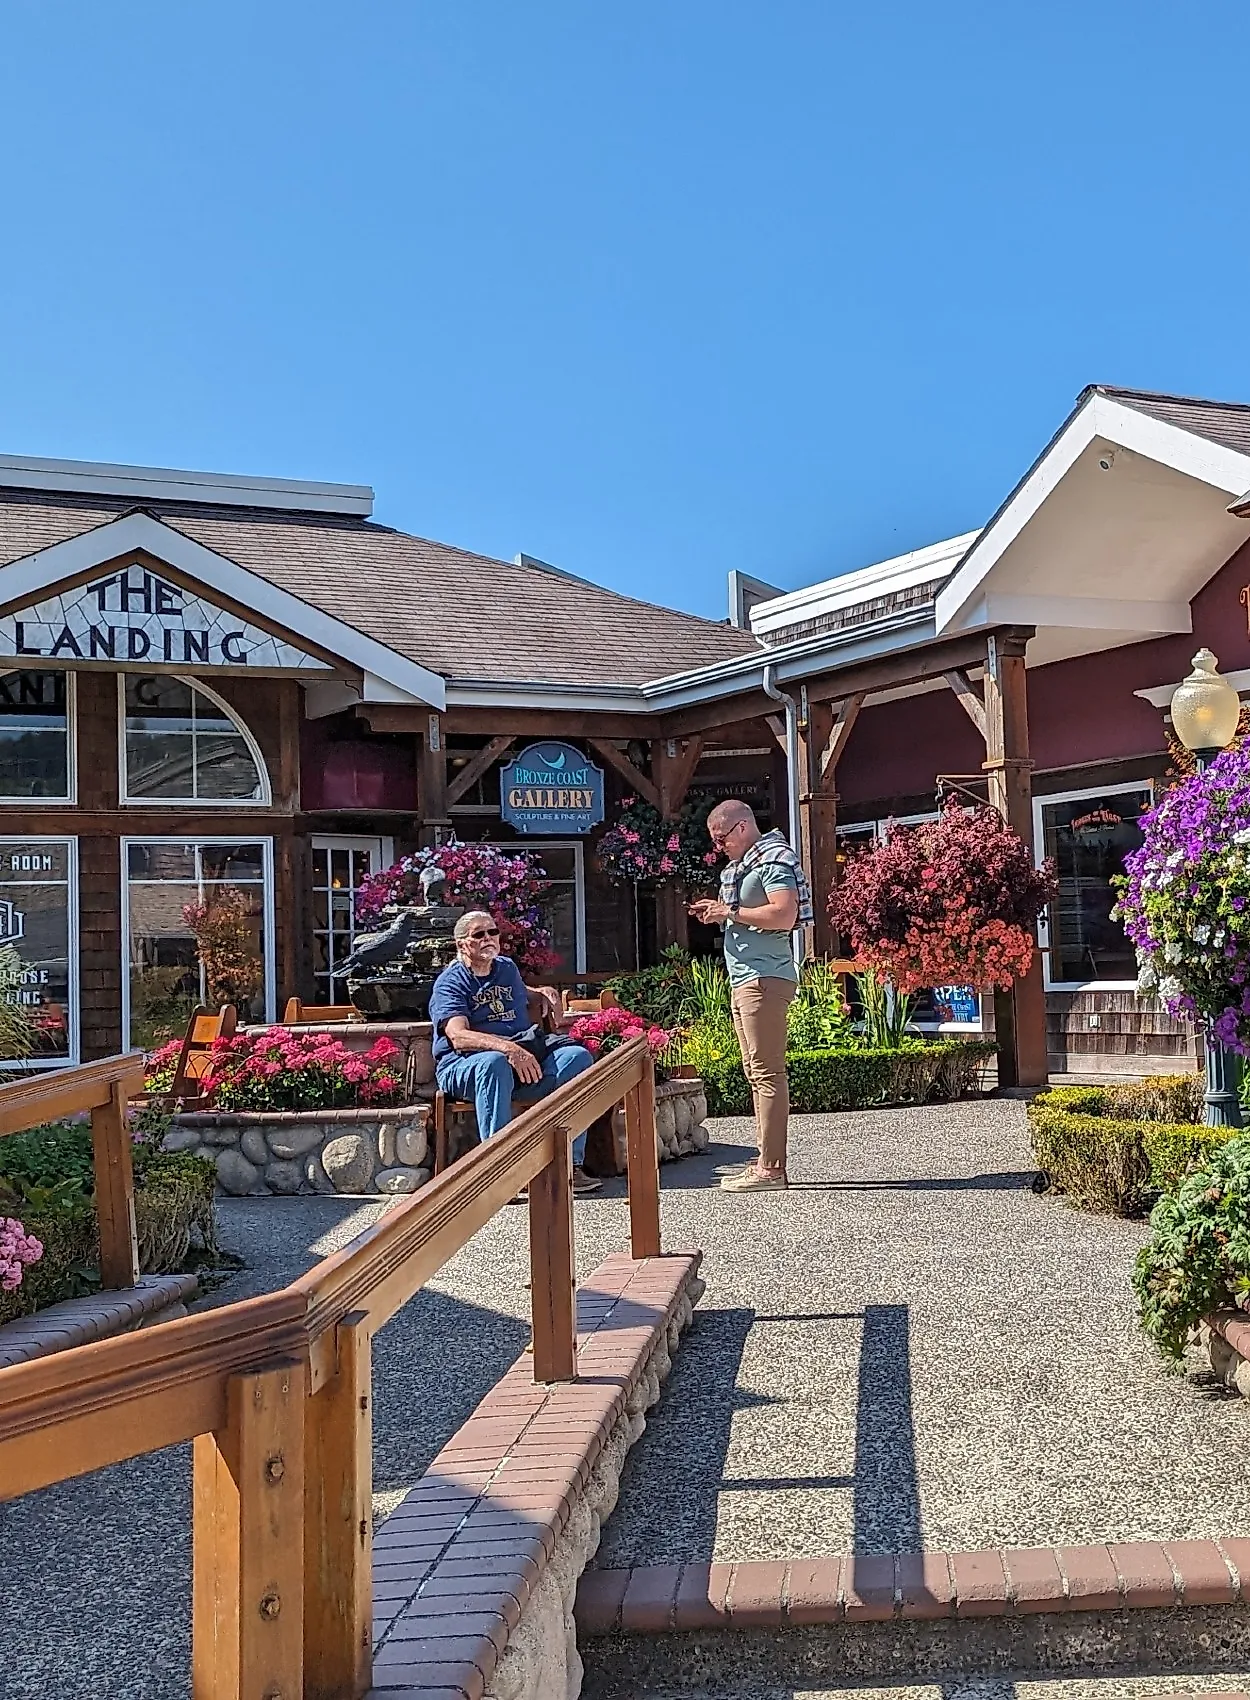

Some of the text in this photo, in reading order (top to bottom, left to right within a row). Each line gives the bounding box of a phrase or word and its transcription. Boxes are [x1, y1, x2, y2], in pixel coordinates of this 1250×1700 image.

[87, 572, 183, 616] THE
[16, 622, 247, 664] LANDING
[515, 768, 589, 785] BRONZE COAST
[508, 788, 595, 809] GALLERY
[11, 855, 52, 871] ROOM
